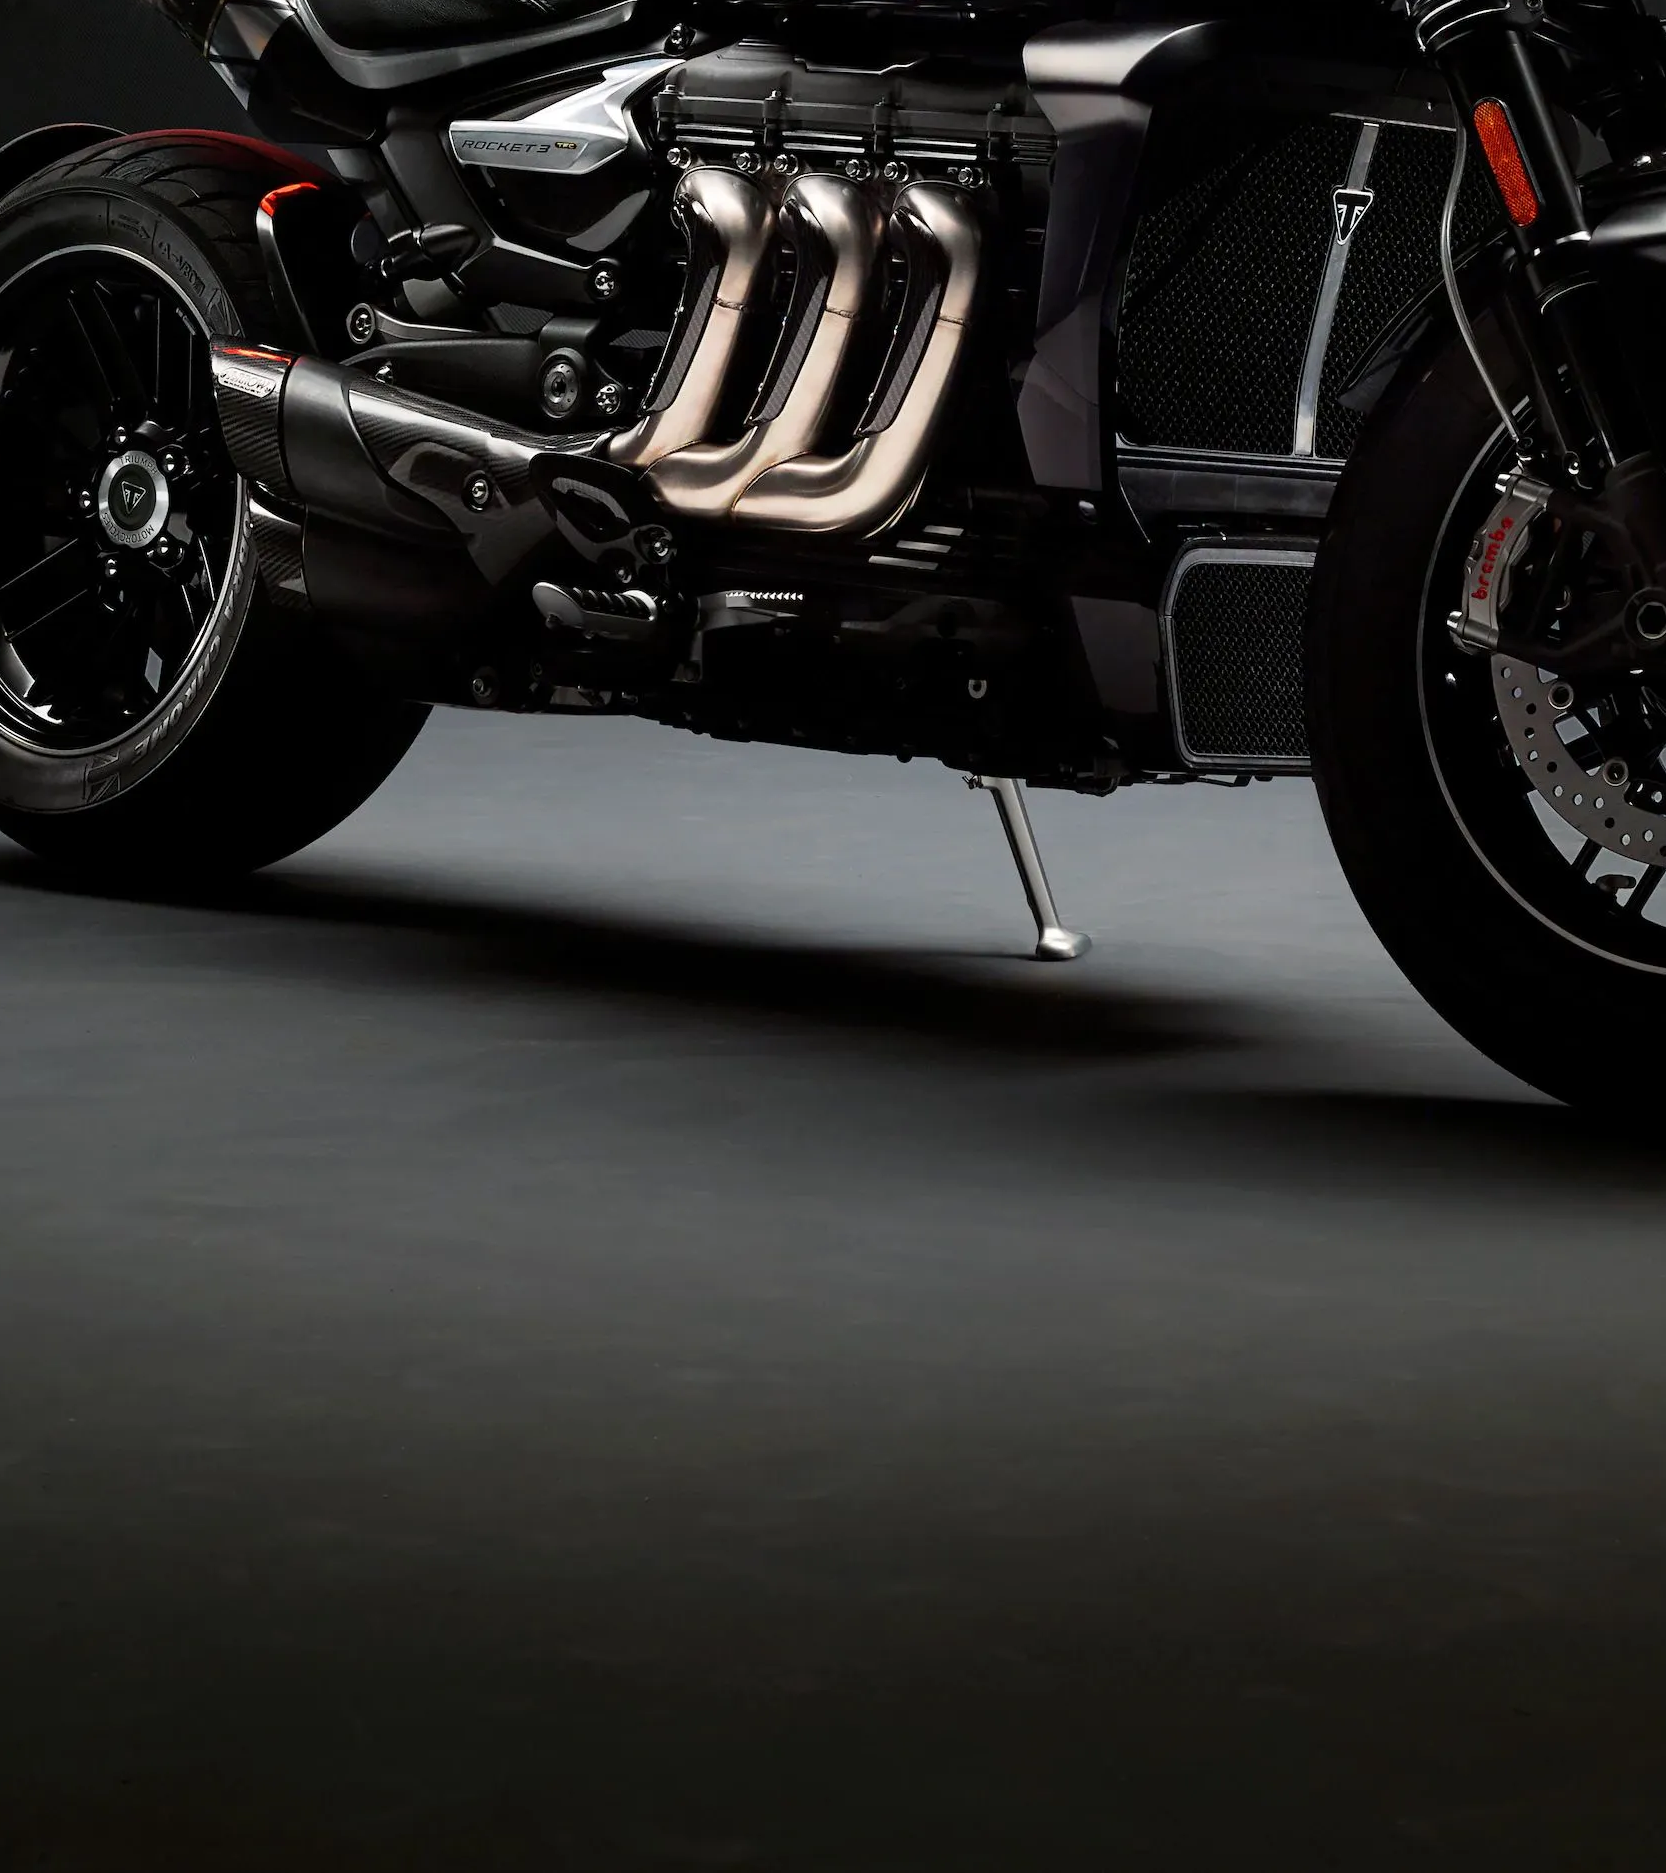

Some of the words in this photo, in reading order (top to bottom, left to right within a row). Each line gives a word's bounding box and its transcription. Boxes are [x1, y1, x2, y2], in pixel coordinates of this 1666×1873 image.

[120, 455, 158, 474] TRIUMPH
[1471, 516, 1514, 600] brembo
[133, 635, 221, 764] CHROME
